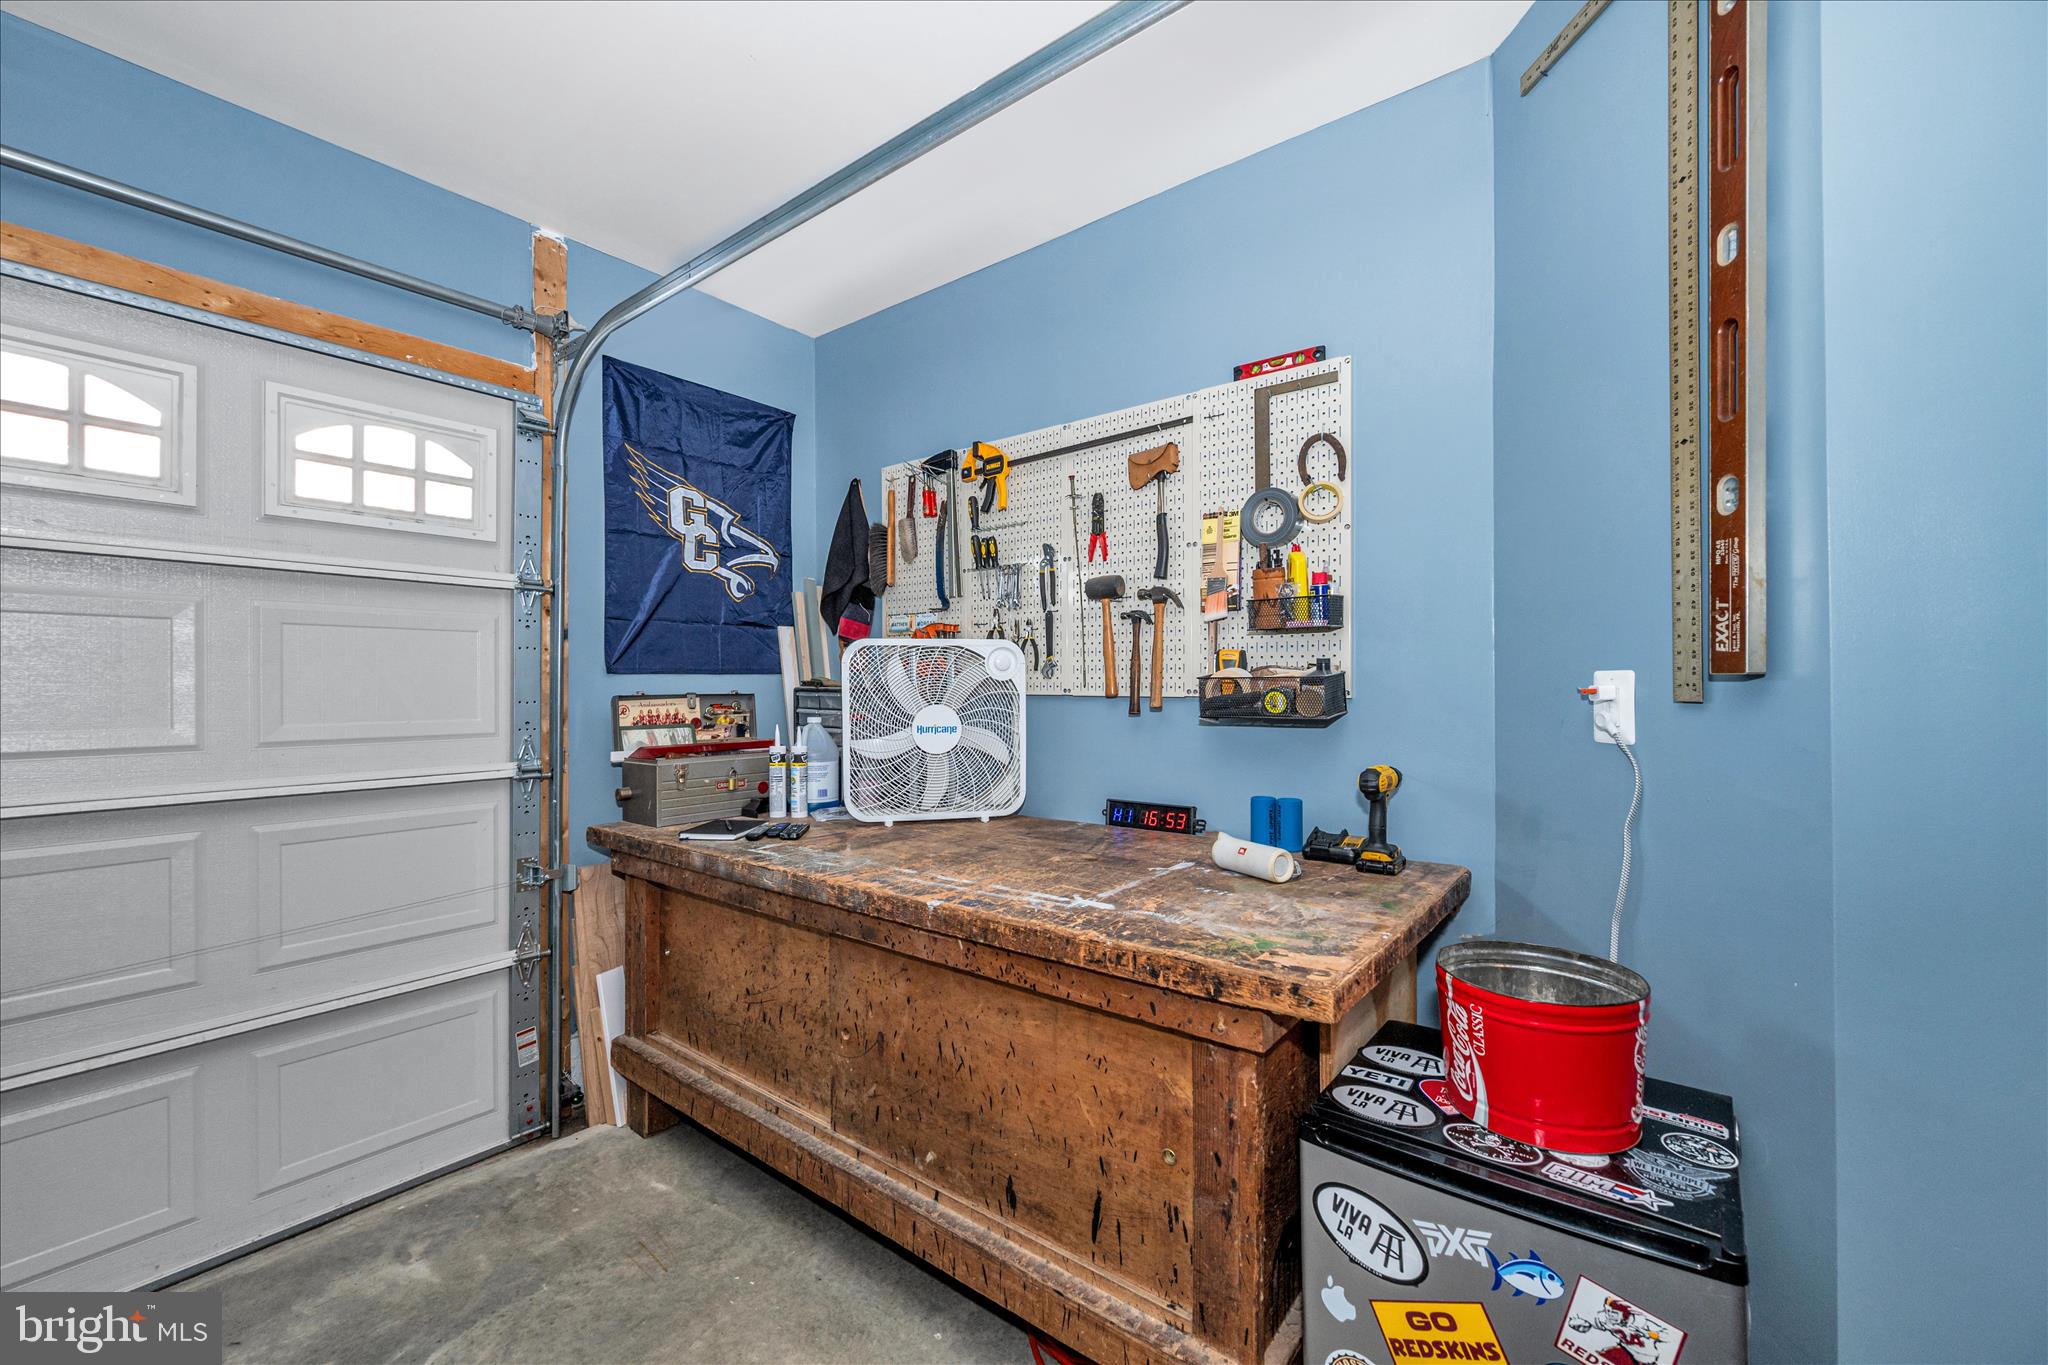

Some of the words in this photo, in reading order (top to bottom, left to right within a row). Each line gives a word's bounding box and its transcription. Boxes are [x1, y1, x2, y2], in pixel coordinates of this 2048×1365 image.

[1716, 601, 1729, 652] EXACT
[916, 725, 958, 735] Hurricane
[1144, 810, 1187, 829] 16:53
[1470, 1003, 1486, 1056] CLASSIC
[1375, 1047, 1411, 1061] VIVA
[1380, 1056, 1395, 1064] LA
[1350, 1067, 1407, 1087] YETI
[1347, 1088, 1387, 1106] VIVA
[1351, 1099, 1368, 1108] LA
[1547, 1164, 1617, 1192] AIM
[1332, 1192, 1372, 1236] VIVA
[1337, 1219, 1353, 1241] LA
[1412, 1218, 1492, 1268] PXG
[1405, 1311, 1458, 1332] GO
[1388, 1338, 1501, 1361] REDSKINS
